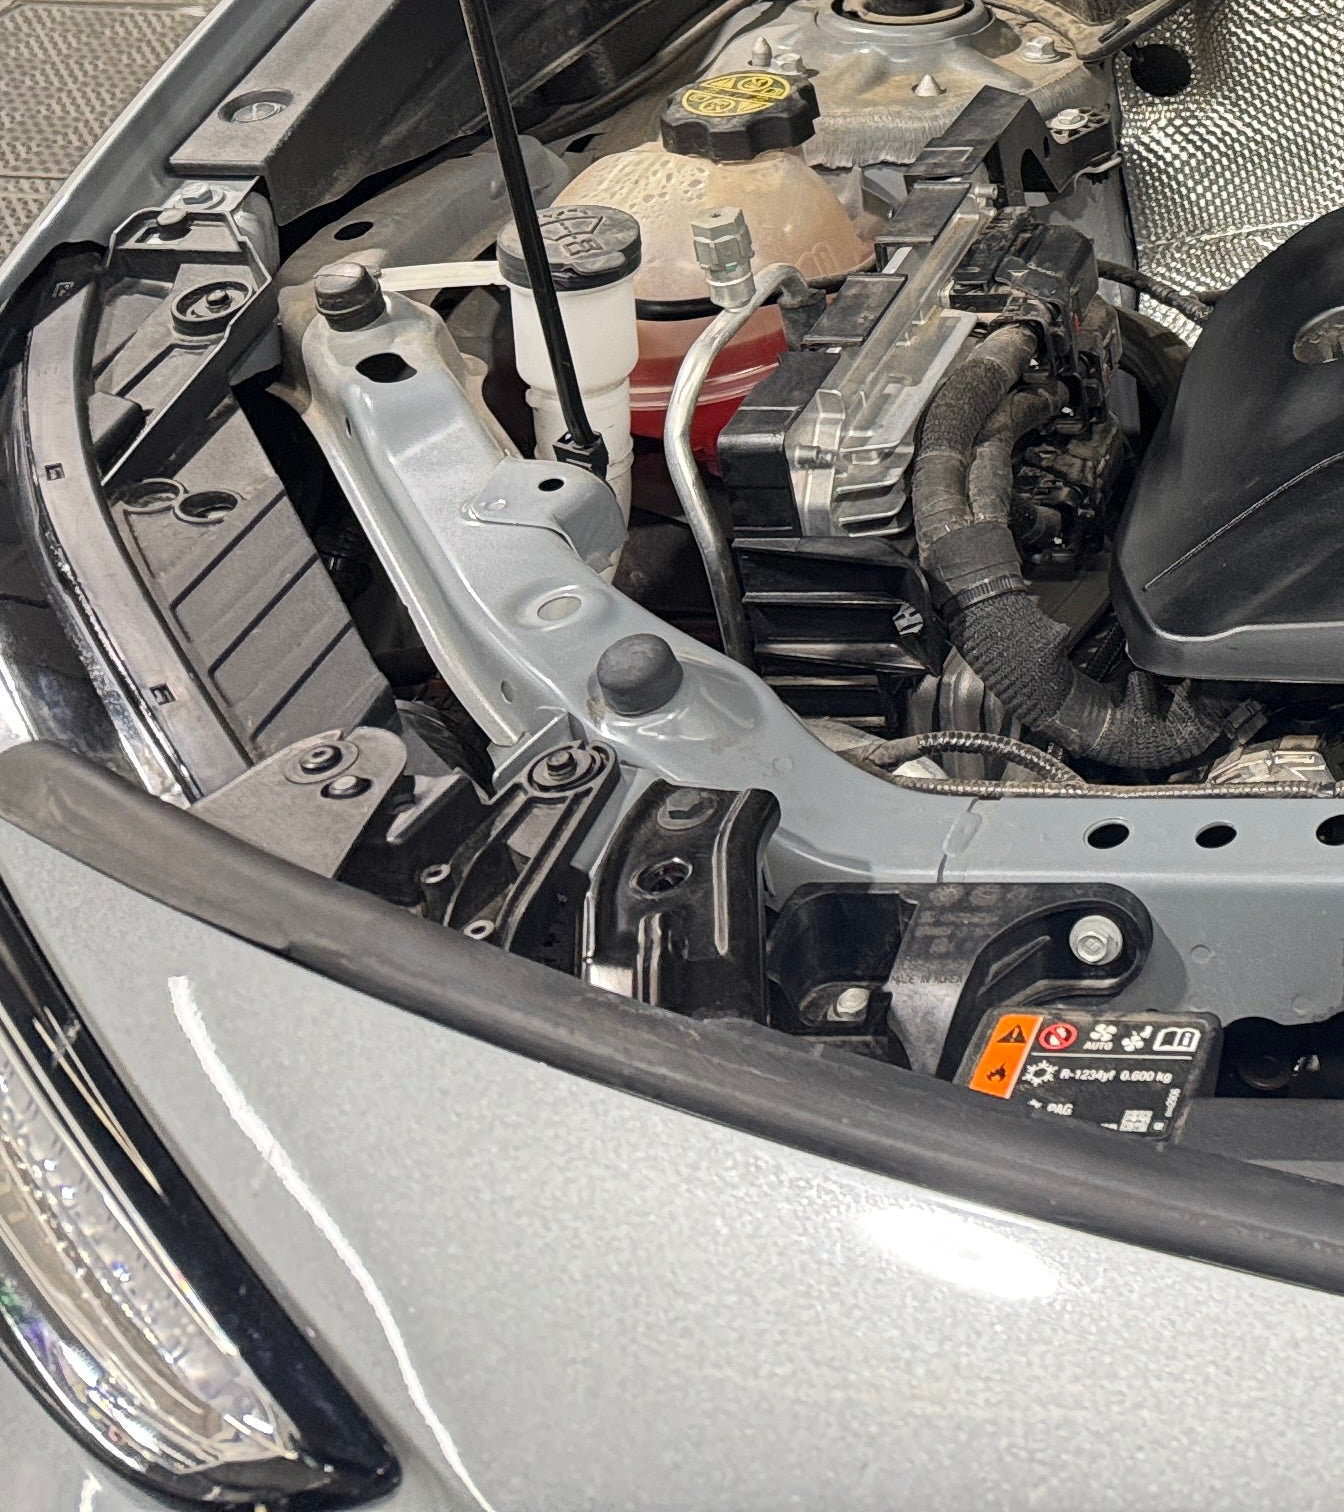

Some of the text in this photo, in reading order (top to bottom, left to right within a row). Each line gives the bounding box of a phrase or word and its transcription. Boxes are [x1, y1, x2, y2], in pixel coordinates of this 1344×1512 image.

[1082, 1041, 1113, 1051] AUTO
[1059, 1068, 1117, 1083] R-1234yf
[1156, 1071, 1173, 1085] kg
